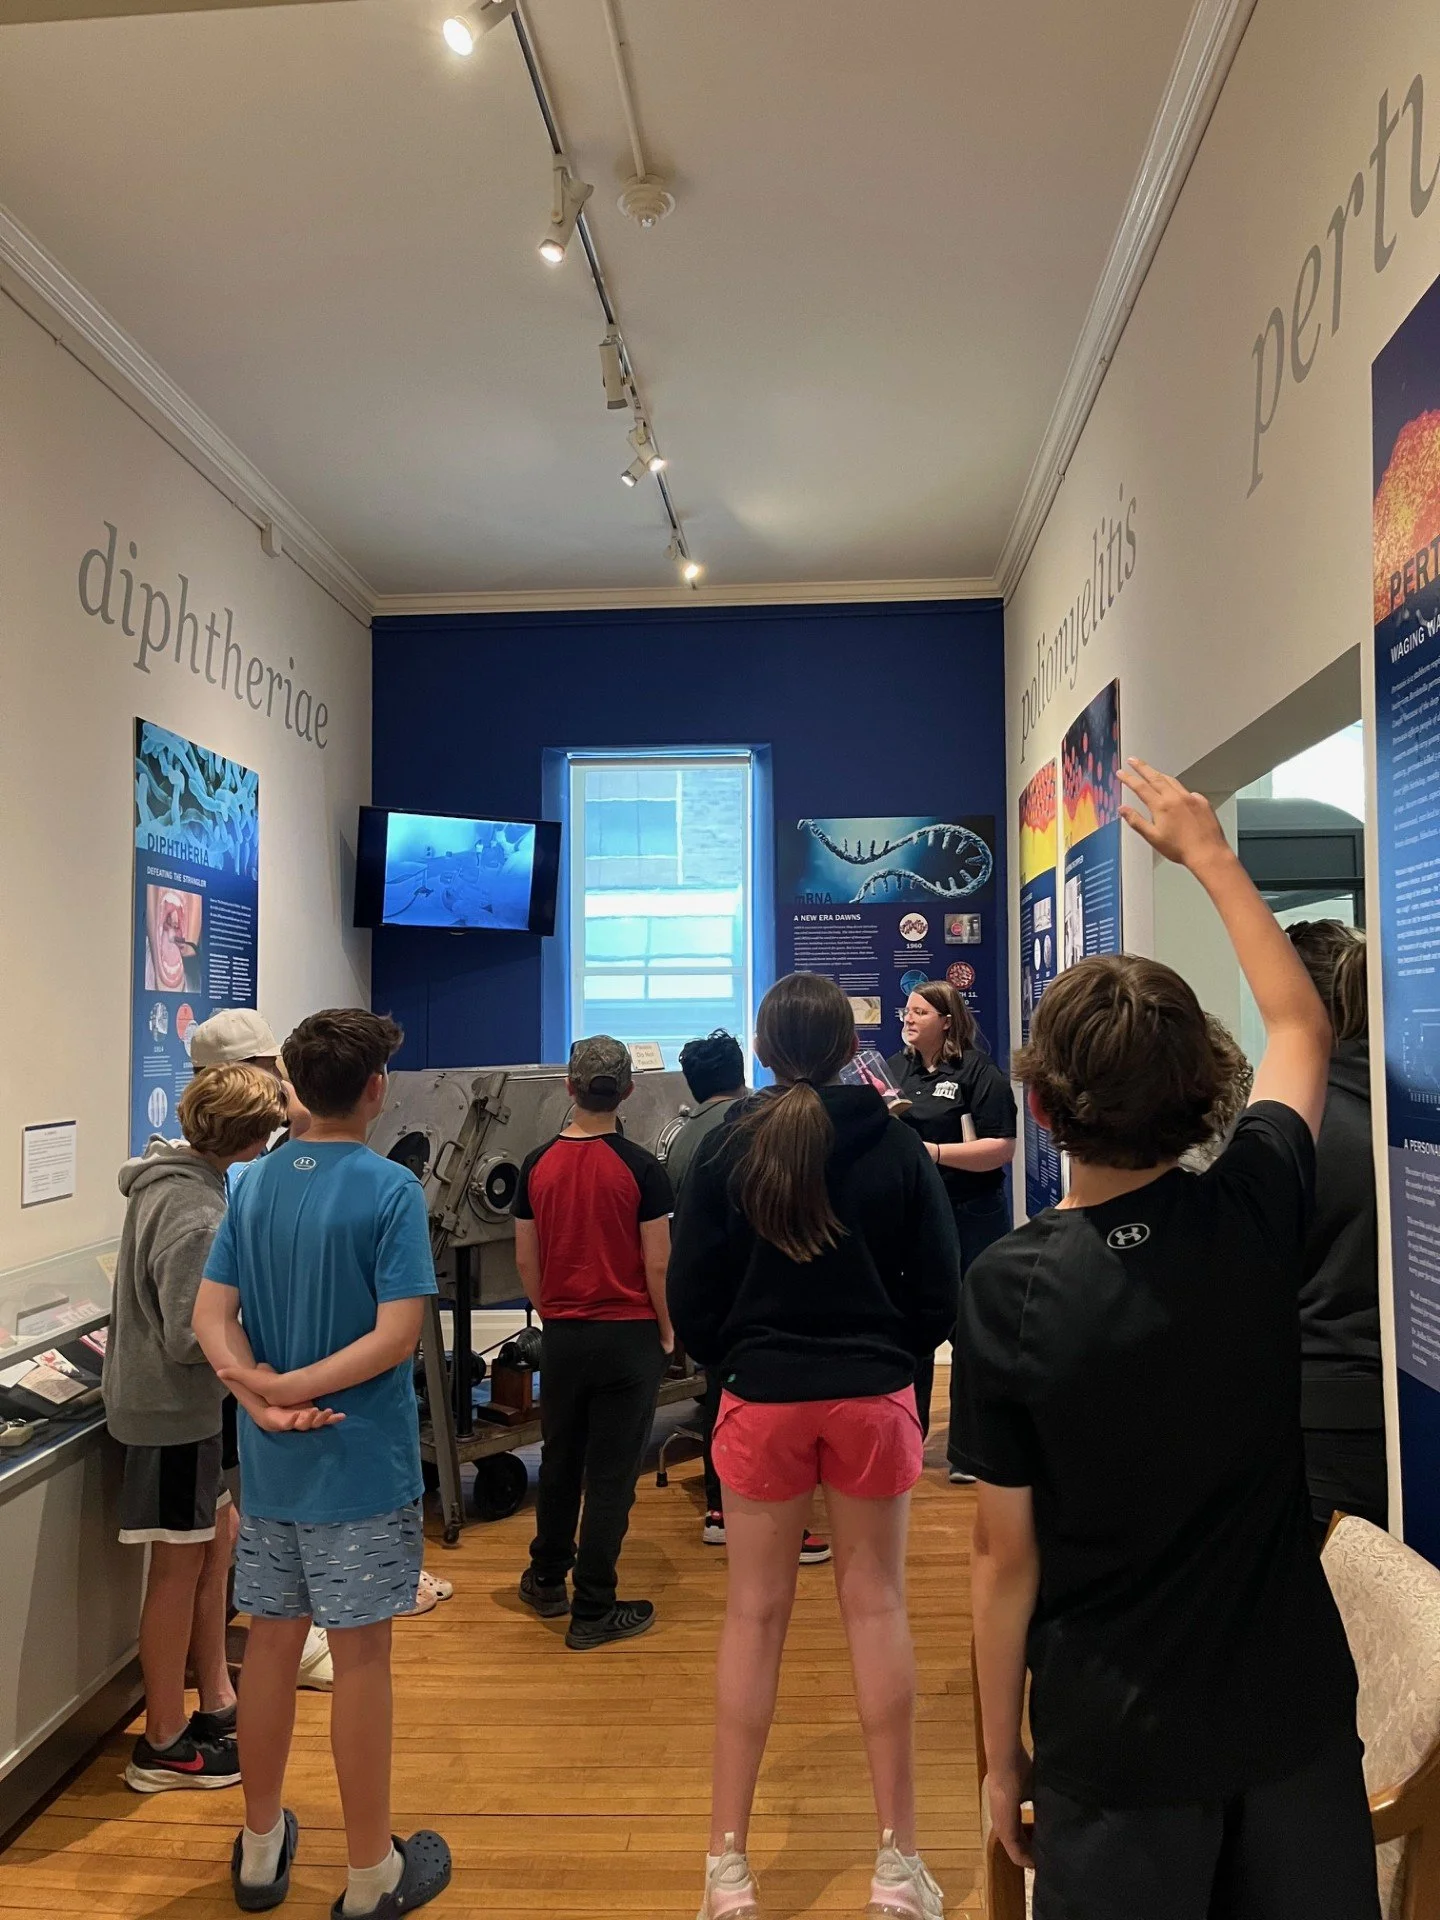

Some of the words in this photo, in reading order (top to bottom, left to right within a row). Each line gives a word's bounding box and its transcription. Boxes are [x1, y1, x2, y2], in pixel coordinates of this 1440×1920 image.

[78, 520, 329, 750] diphtheriae
[1020, 482, 1137, 764] poliomyelitis
[1390, 626, 1424, 664] WAGING
[147, 833, 209, 867] DIPHTHERIA
[147, 866, 173, 880] DEFEATING
[173, 872, 182, 882] THE
[795, 892, 833, 904] mRNA
[800, 914, 817, 922] NEW
[835, 913, 861, 921] DAWNS
[1403, 1138, 1409, 1150] A
